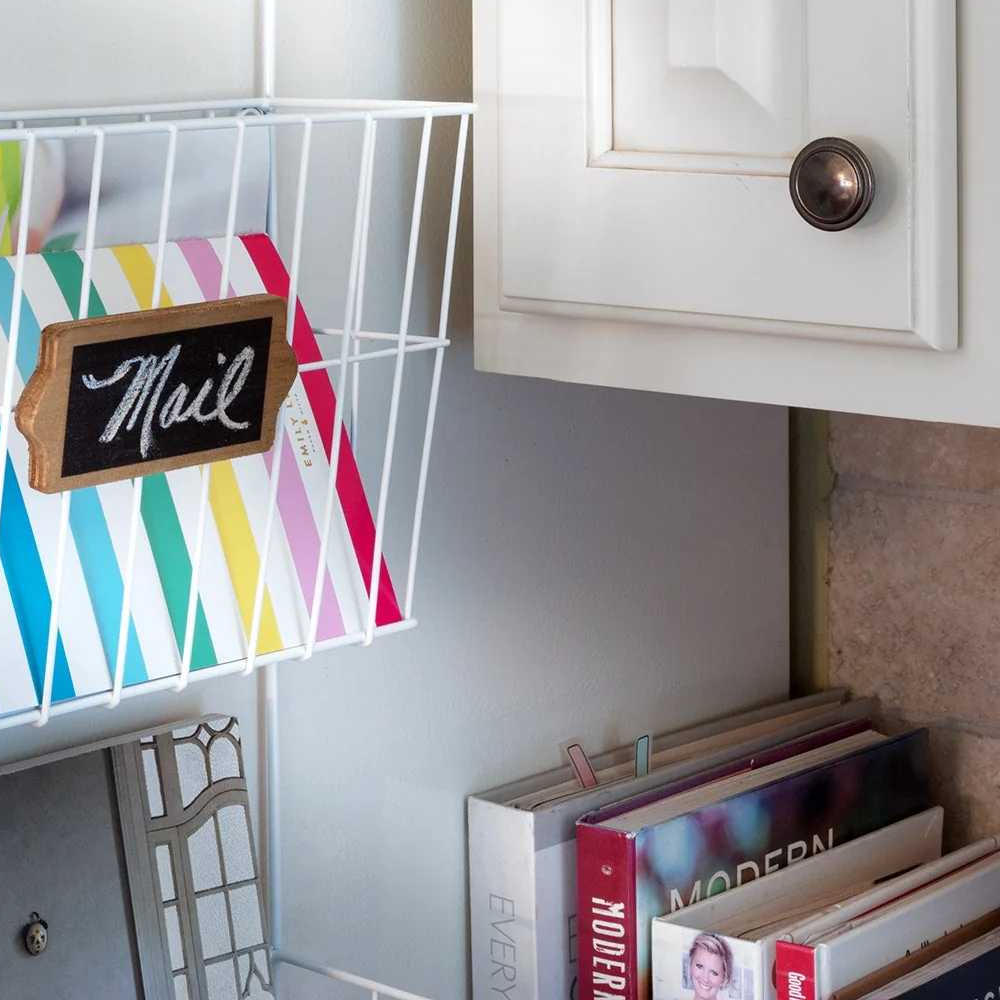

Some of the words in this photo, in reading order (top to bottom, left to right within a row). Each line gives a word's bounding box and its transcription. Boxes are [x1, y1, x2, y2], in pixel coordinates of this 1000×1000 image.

[81, 343, 256, 459] Mail
[290, 417, 313, 468] EMILY
[489, 893, 517, 1000] EVERY
[591, 896, 626, 1000] MODERN
